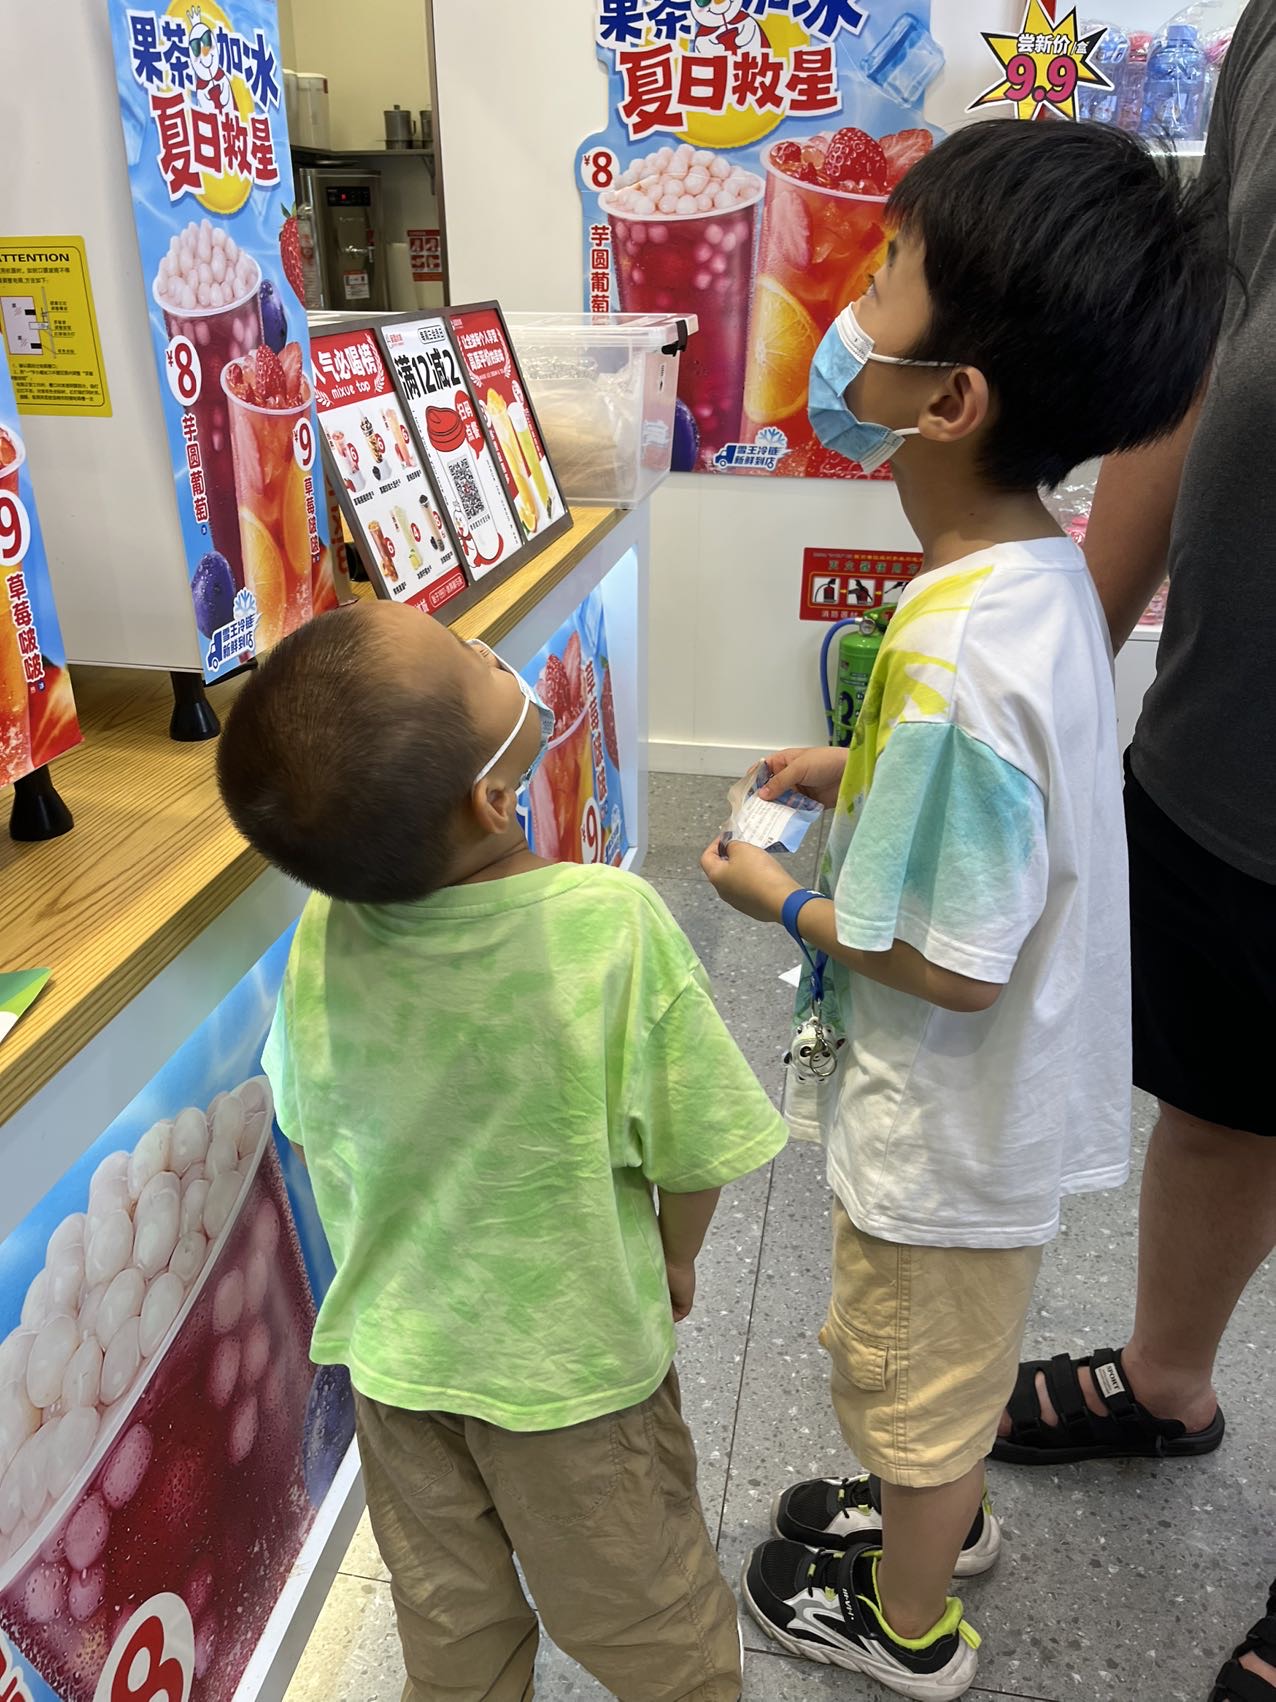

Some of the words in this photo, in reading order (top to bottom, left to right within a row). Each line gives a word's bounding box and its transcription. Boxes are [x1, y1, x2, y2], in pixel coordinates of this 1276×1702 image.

[619, 43, 838, 136] 夏日救星
[1004, 54, 1078, 102] 9.9
[151, 92, 279, 195] 夏日救星
[331, 384, 356, 399] mixue
[355, 380, 371, 393] top
[394, 348, 462, 401] 满12减2
[182, 415, 208, 522] 芋圆葡萄
[733, 456, 777, 469] 新鲜到店
[7, 573, 44, 681] 草莓啵啵
[222, 613, 256, 641] 雪王冷链
[222, 630, 254, 659] 新鲜到店
